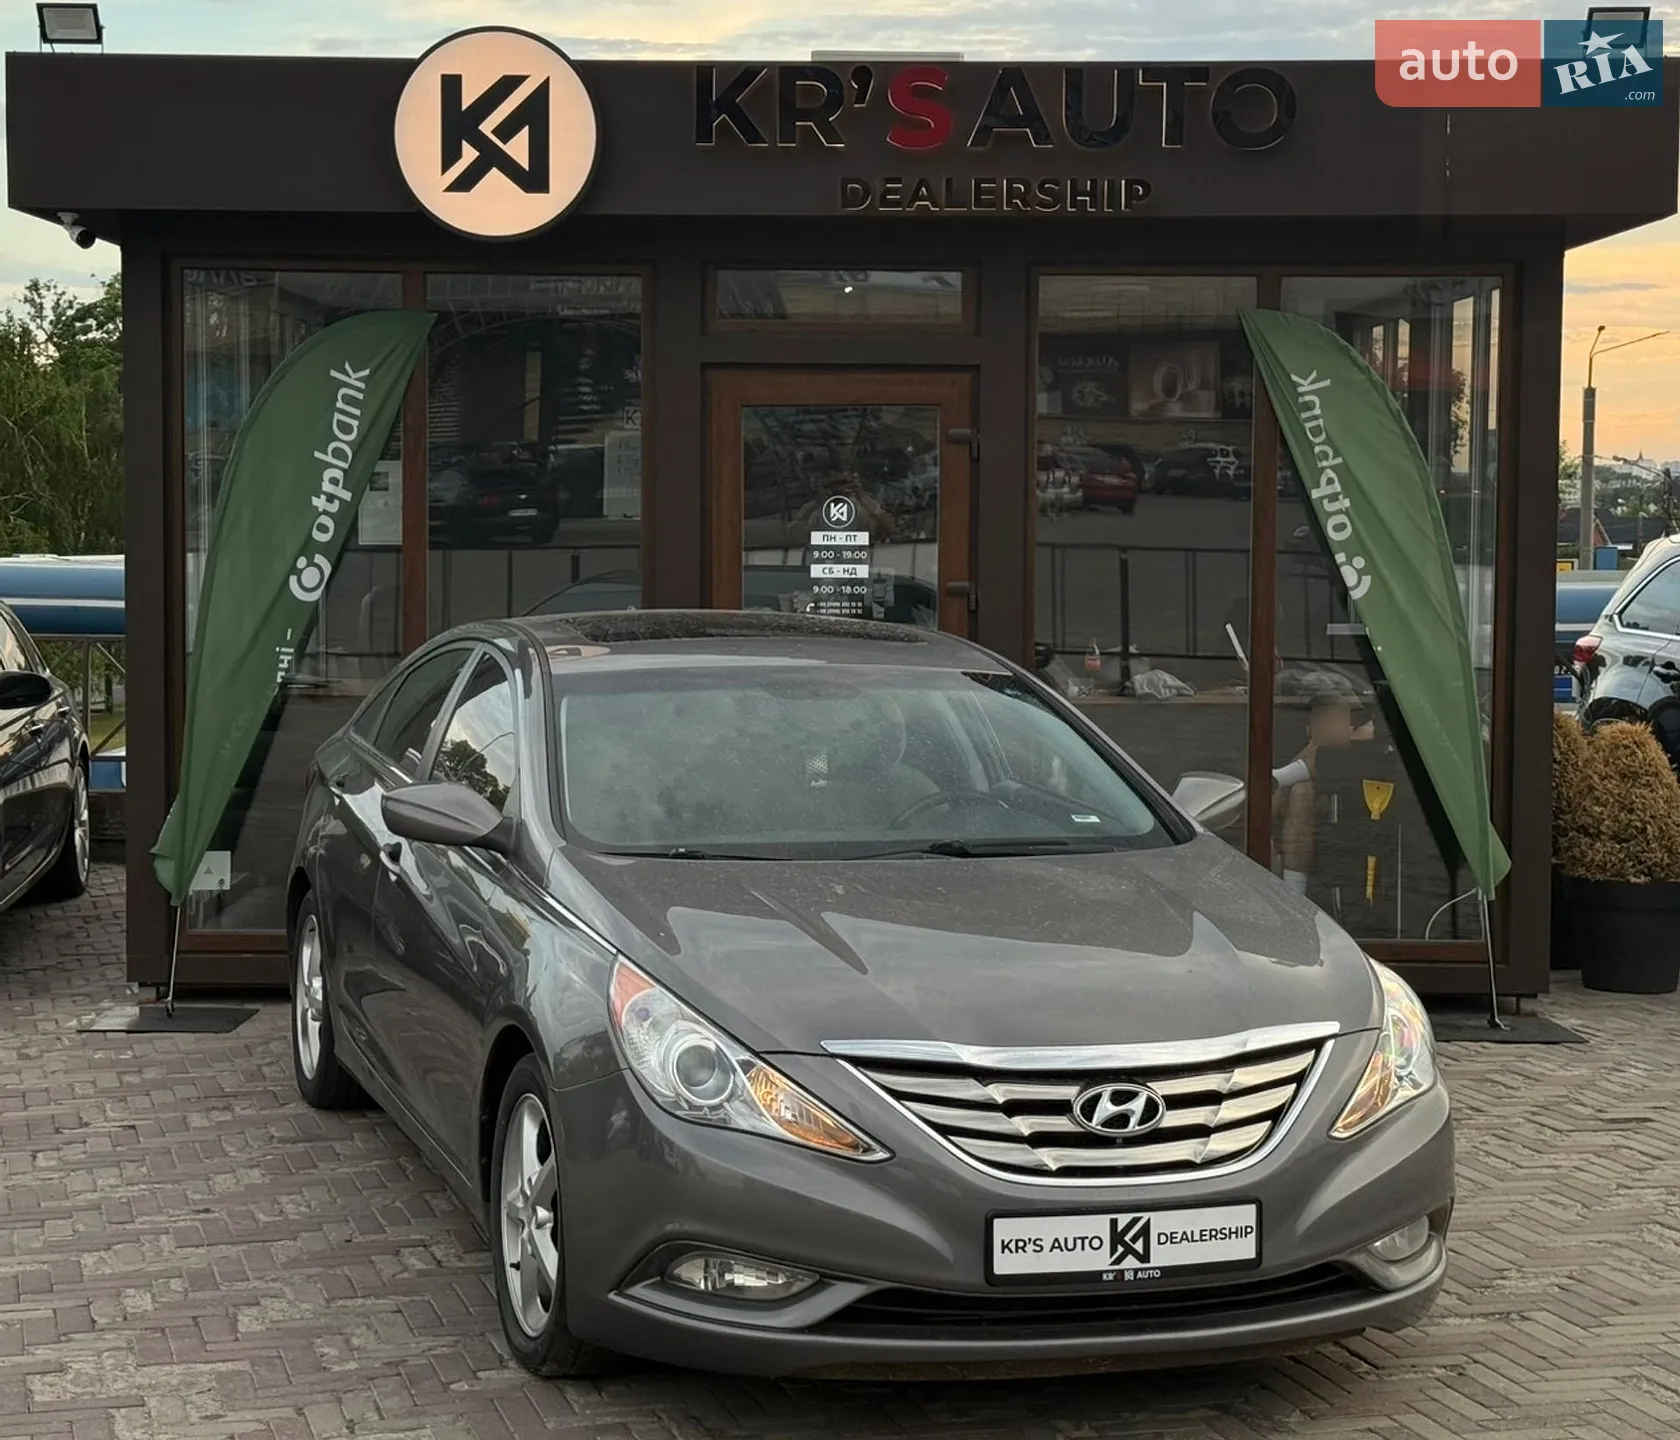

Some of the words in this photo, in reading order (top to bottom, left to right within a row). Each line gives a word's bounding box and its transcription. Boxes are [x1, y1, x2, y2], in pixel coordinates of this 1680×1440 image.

[966, 65, 1299, 151] AUTO
[840, 176, 1153, 213] DEALERSHIP
[310, 360, 371, 543] otpbank
[822, 534, 836, 543] ПН
[845, 534, 858, 543] ПТ
[822, 566, 834, 575] СБ
[842, 566, 858, 577] НД
[1049, 1234, 1104, 1253] AUTO
[1157, 1225, 1254, 1246] DEALERSHIP
[1136, 1269, 1161, 1279] AUTO
